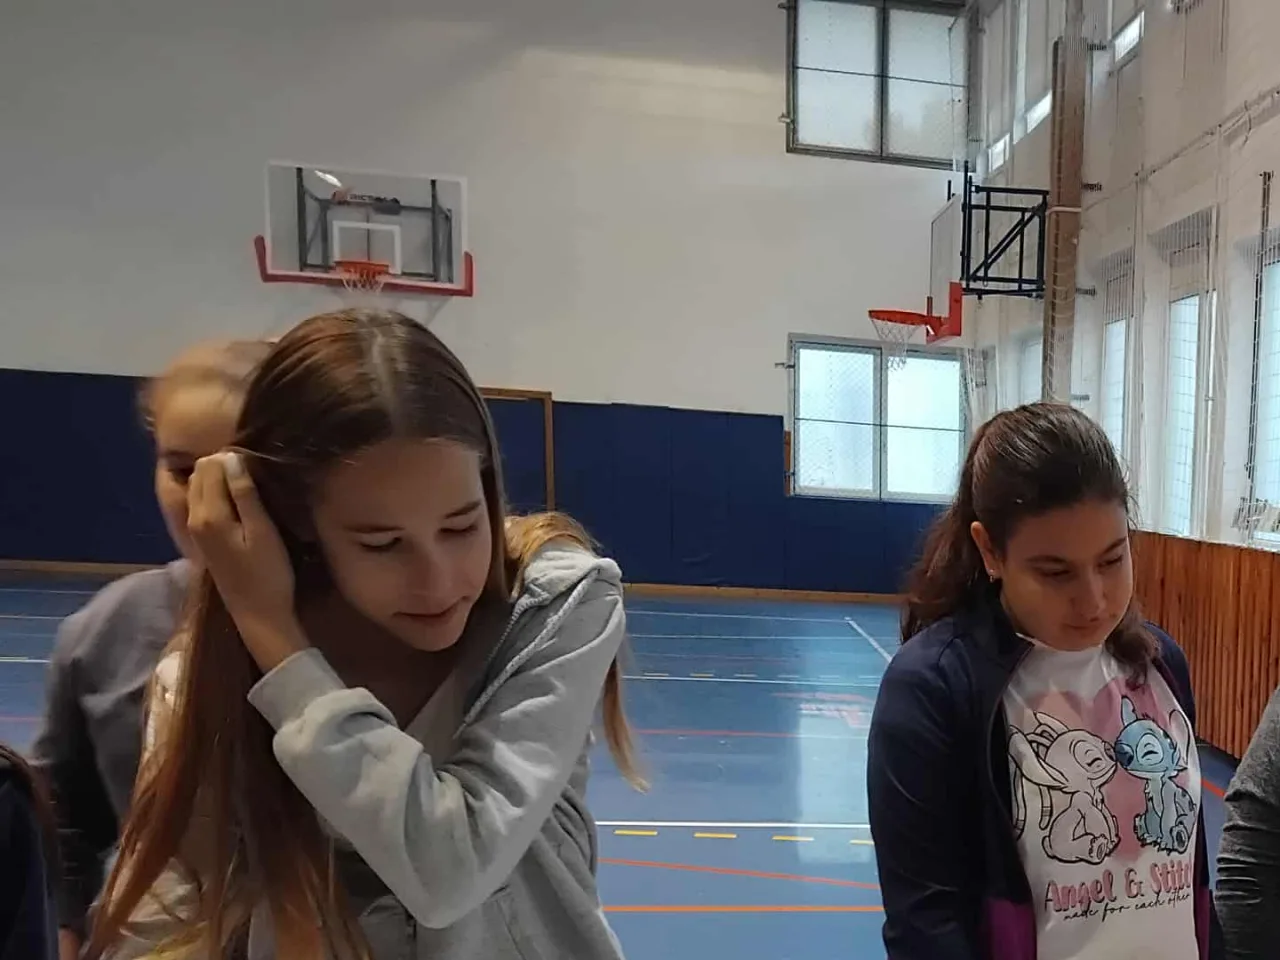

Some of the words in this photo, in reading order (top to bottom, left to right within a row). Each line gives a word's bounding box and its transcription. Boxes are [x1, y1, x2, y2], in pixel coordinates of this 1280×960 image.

[1045, 868, 1117, 911] Angel
[1124, 867, 1145, 898] &
[1063, 906, 1099, 921] made
[1102, 902, 1130, 922] for
[1134, 893, 1166, 910] each
[1167, 890, 1191, 908] other
